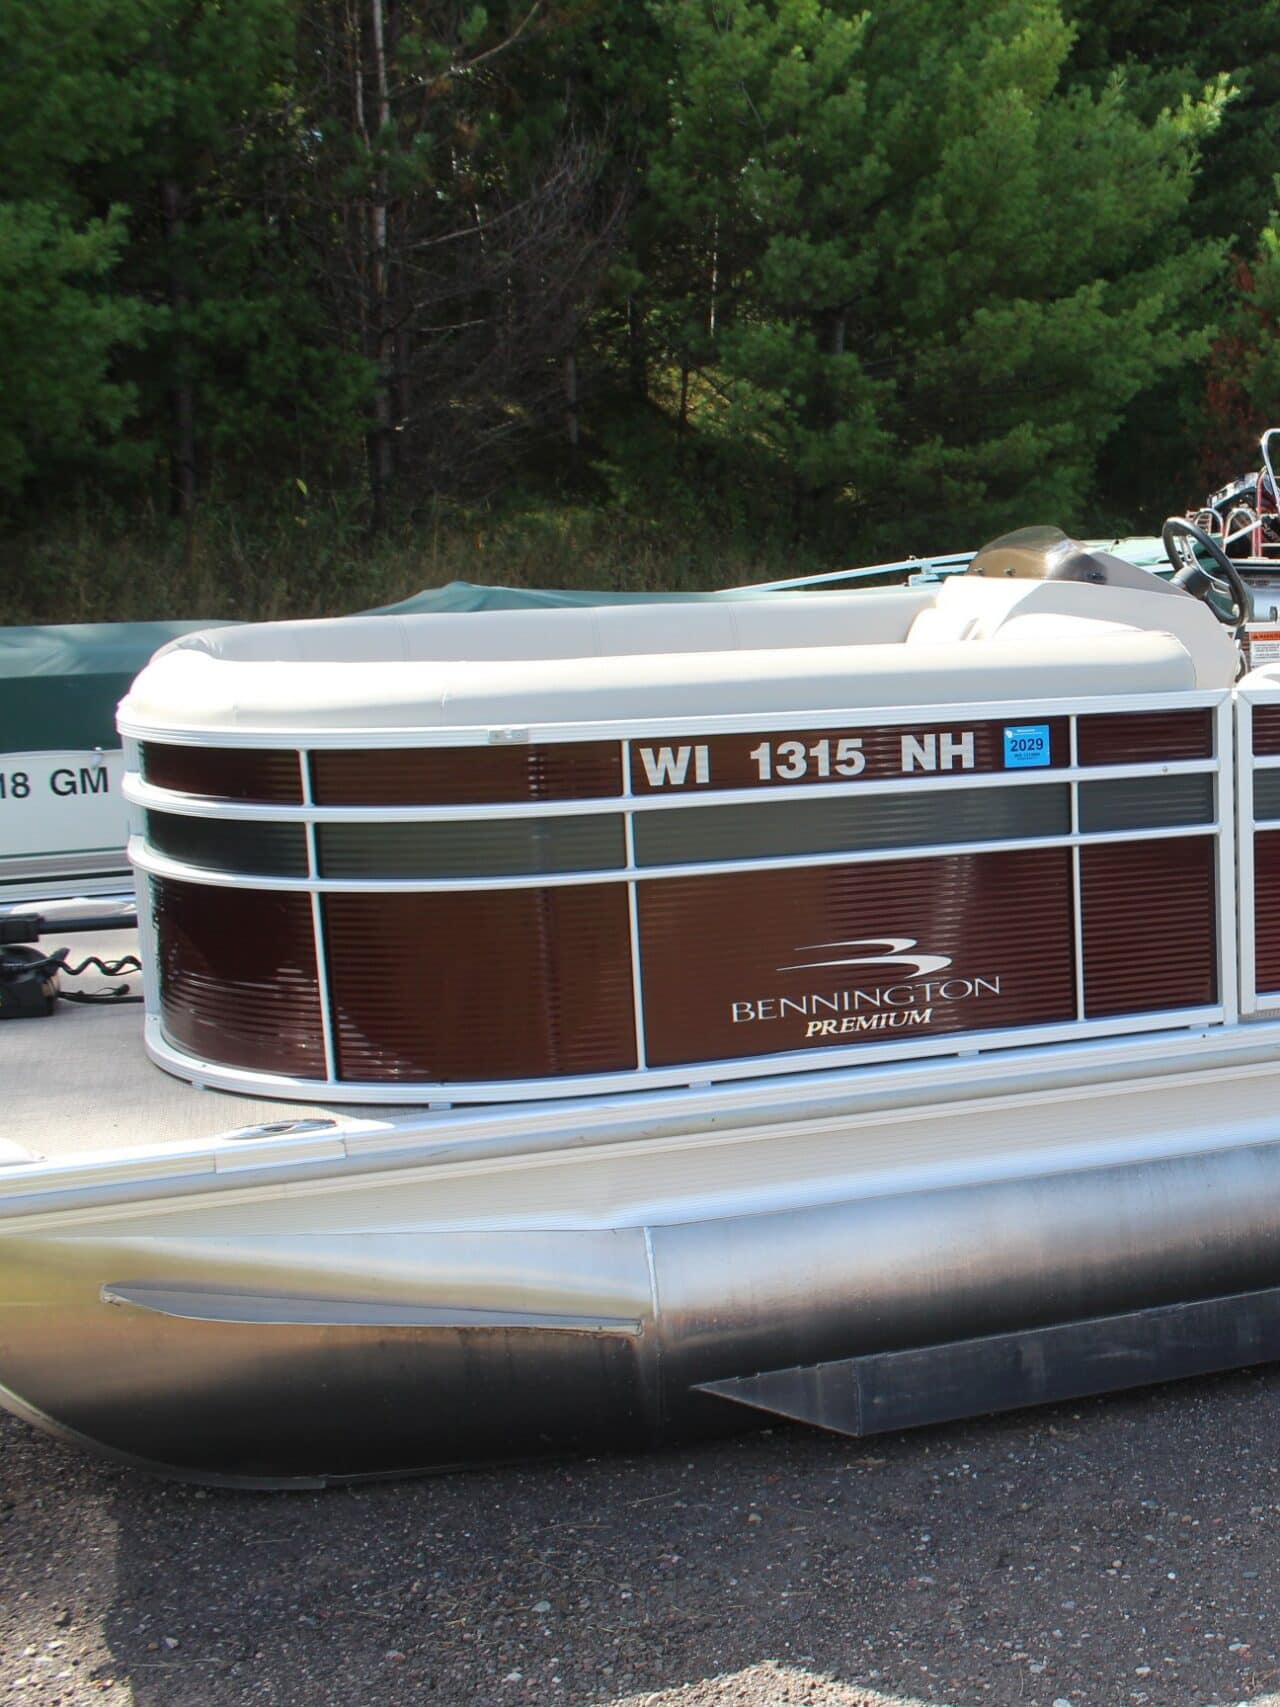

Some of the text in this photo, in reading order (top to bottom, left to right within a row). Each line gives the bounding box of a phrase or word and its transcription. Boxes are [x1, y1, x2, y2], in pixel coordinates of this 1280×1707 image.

[639, 731, 975, 787] WI 1315 NH
[1010, 737, 1044, 752] 2029
[50, 766, 109, 797] GM
[731, 975, 1001, 1023] BENNINGTON
[805, 1007, 933, 1037] PREMIUM
